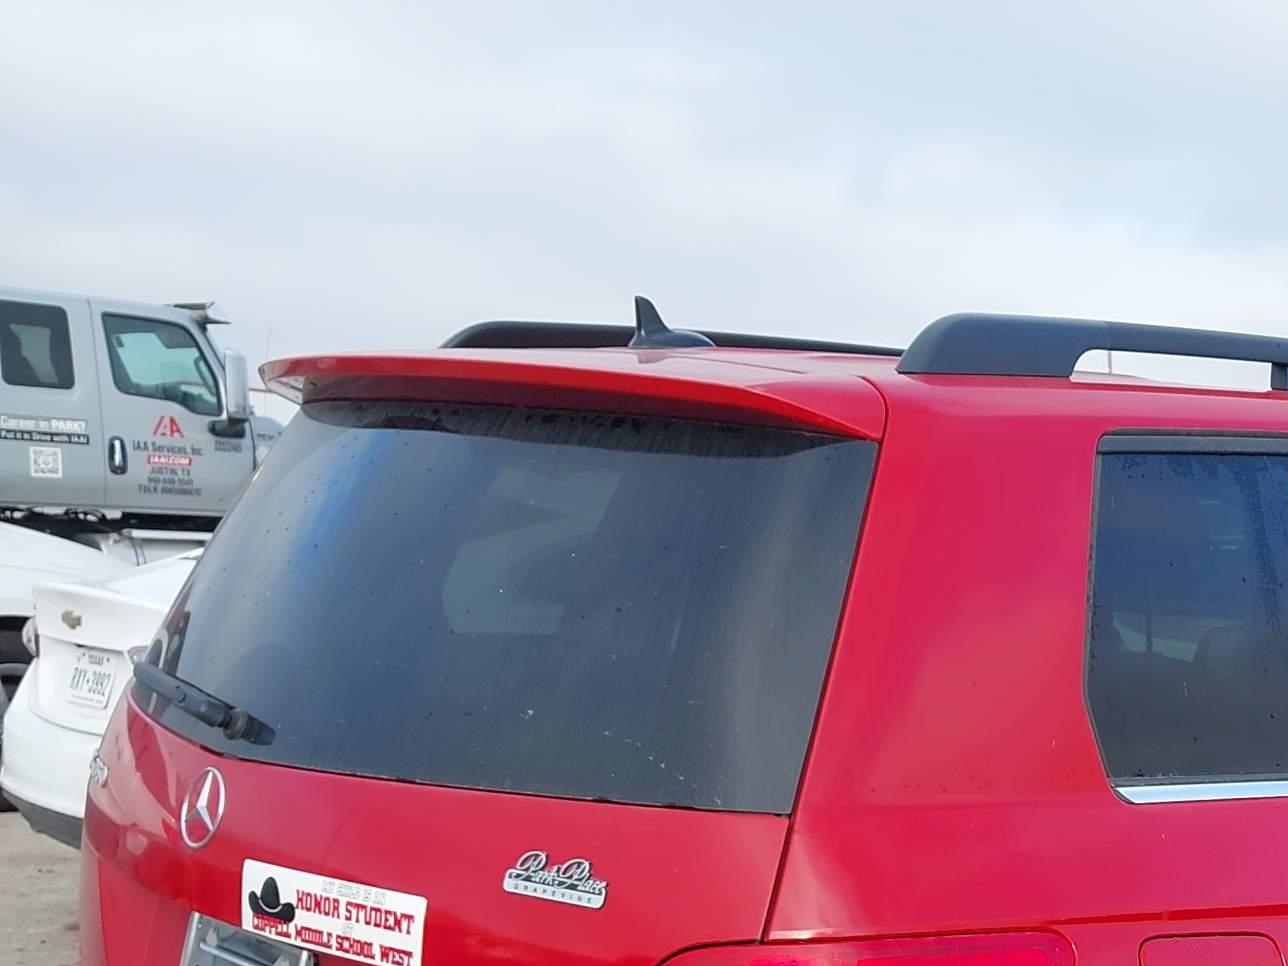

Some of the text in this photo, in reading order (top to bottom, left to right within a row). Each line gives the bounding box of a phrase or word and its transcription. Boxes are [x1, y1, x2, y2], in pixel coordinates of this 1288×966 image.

[51, 419, 86, 433] PARK?
[133, 440, 149, 451] IAA
[88, 654, 105, 666] TEXAS
[512, 851, 607, 894] Park Place
[322, 880, 387, 905] MY CHILD IS AN
[514, 883, 592, 904] GRAPEVINE
[295, 889, 415, 935] HONOR STUDENT
[252, 912, 292, 939] COPPELL
[294, 924, 333, 950] MIDDLE
[335, 934, 376, 960] SCHOOL
